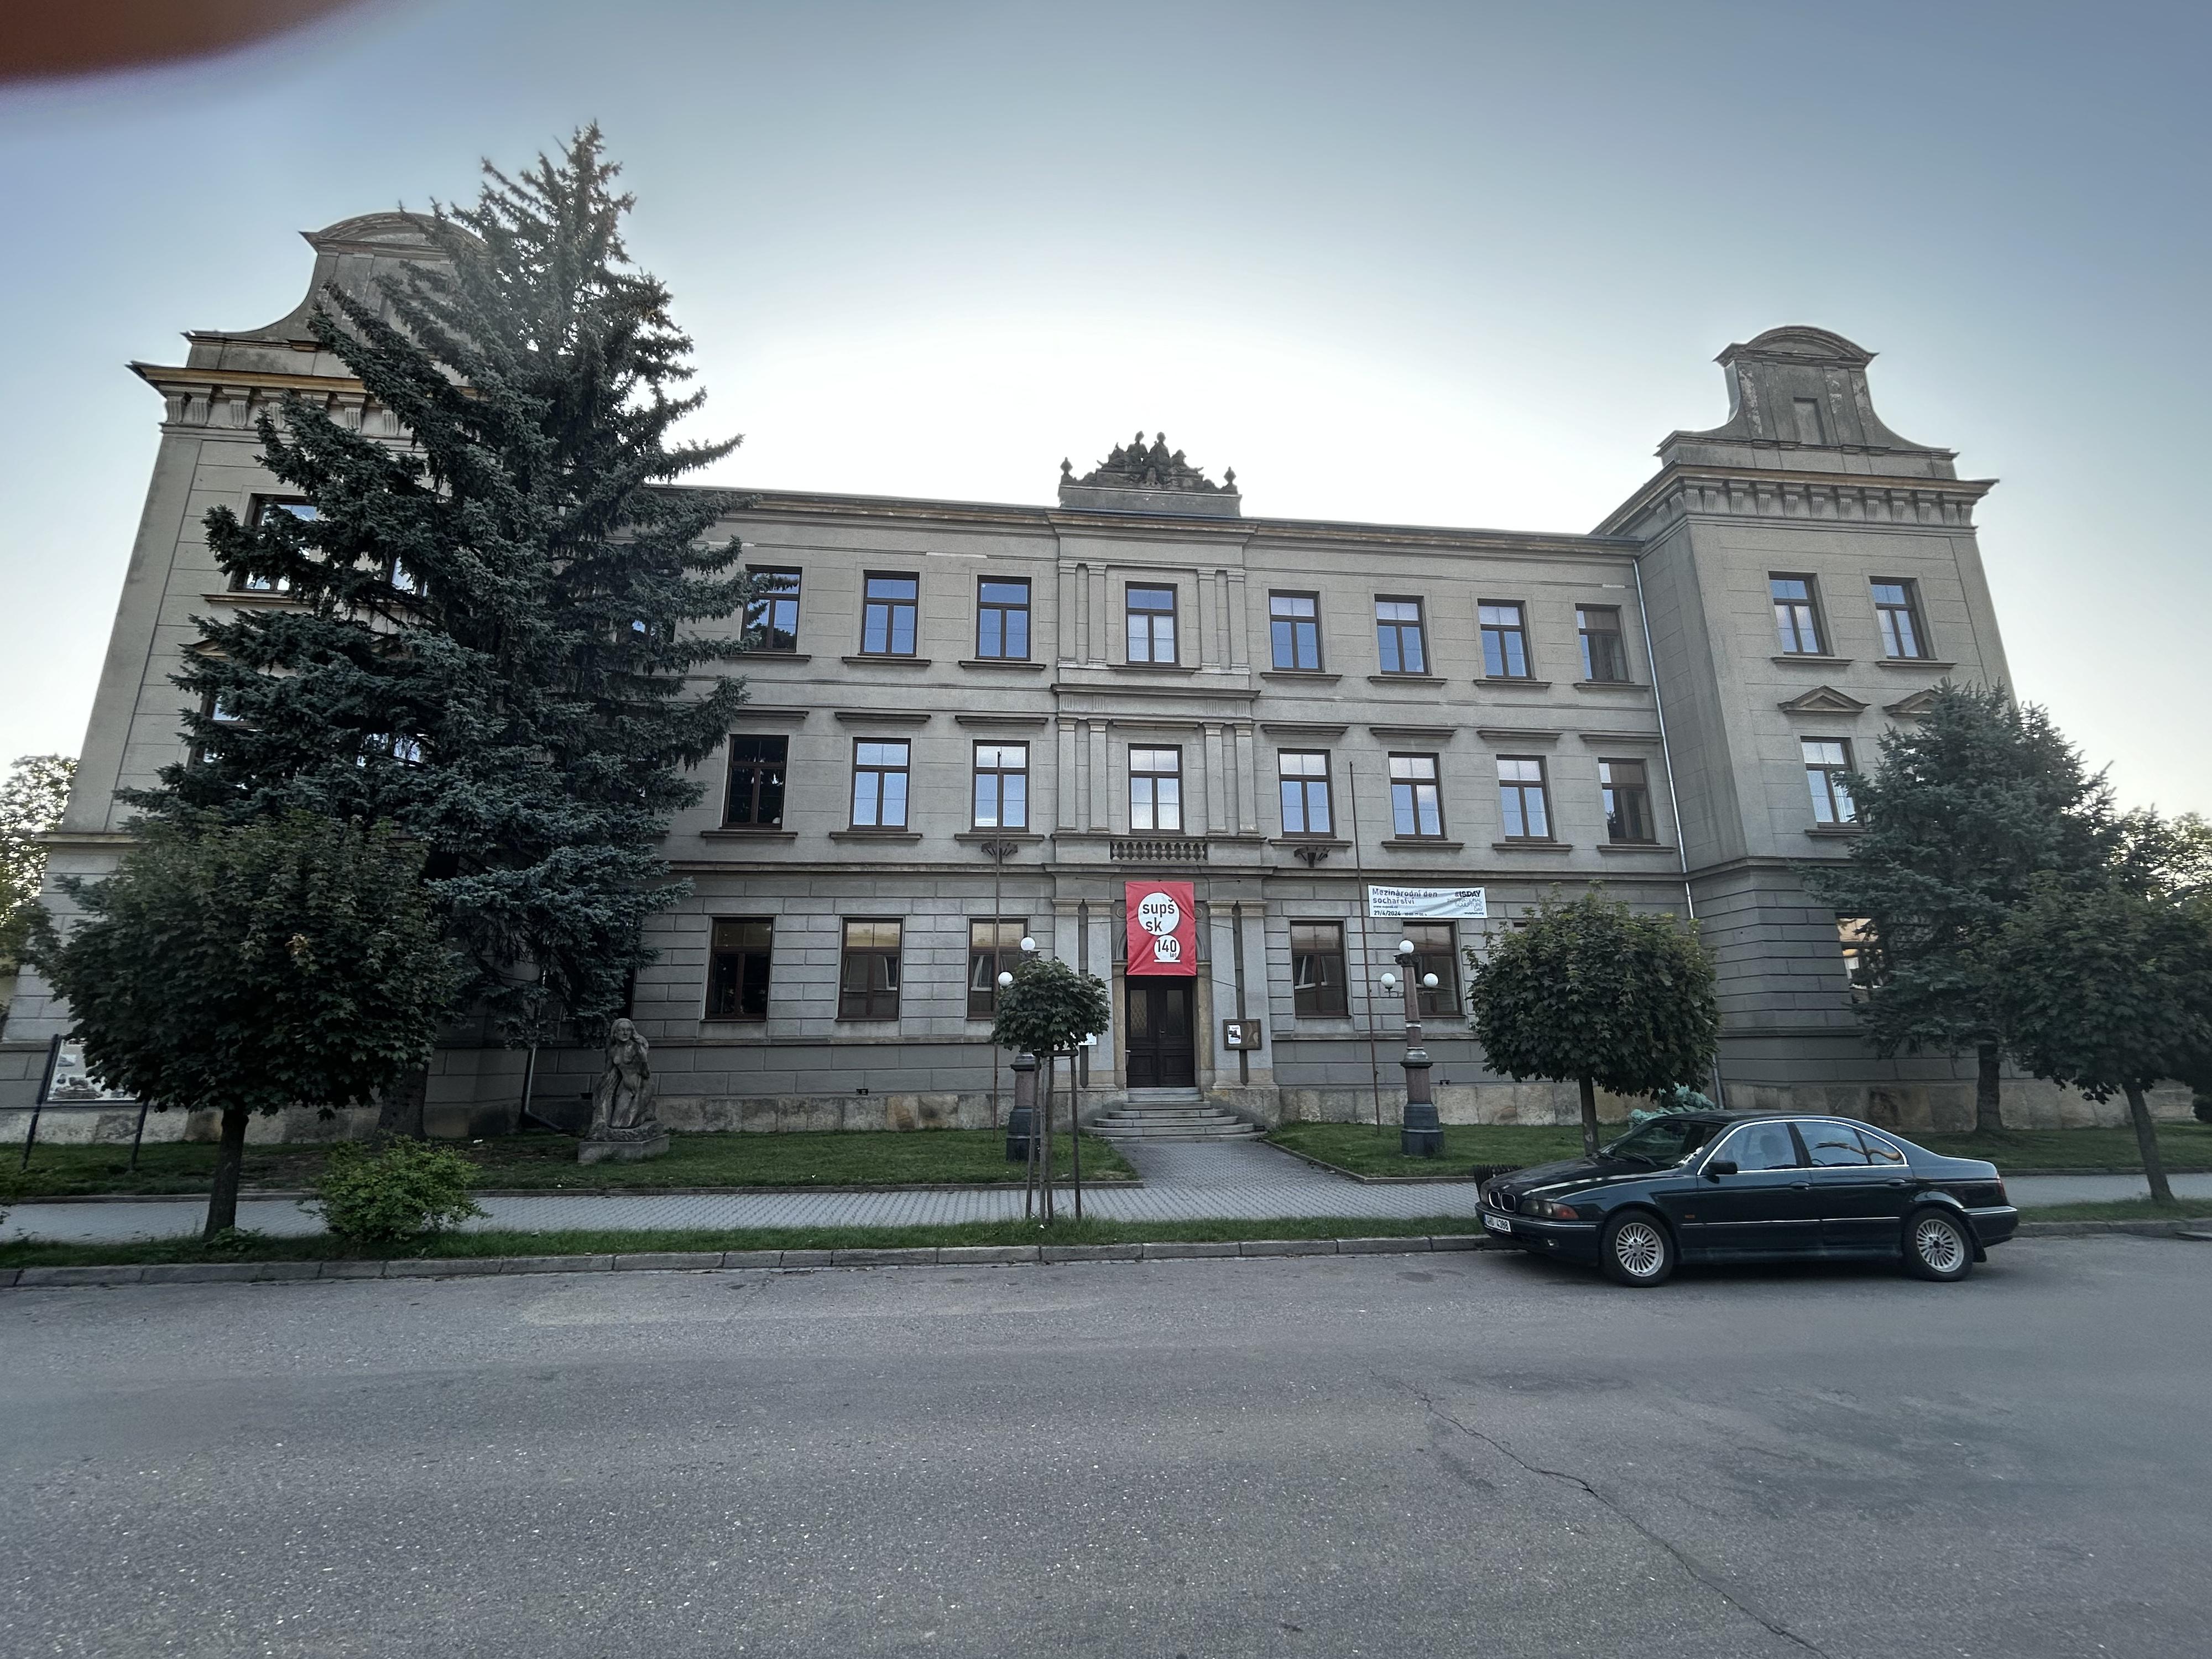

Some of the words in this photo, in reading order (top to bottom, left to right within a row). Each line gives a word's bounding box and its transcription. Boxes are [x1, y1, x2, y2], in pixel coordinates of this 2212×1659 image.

[1372, 888, 1421, 897] Mezinárodní
[1142, 899, 1175, 917] supš
[1146, 917, 1162, 932] sk
[1156, 940, 1176, 952] 140
